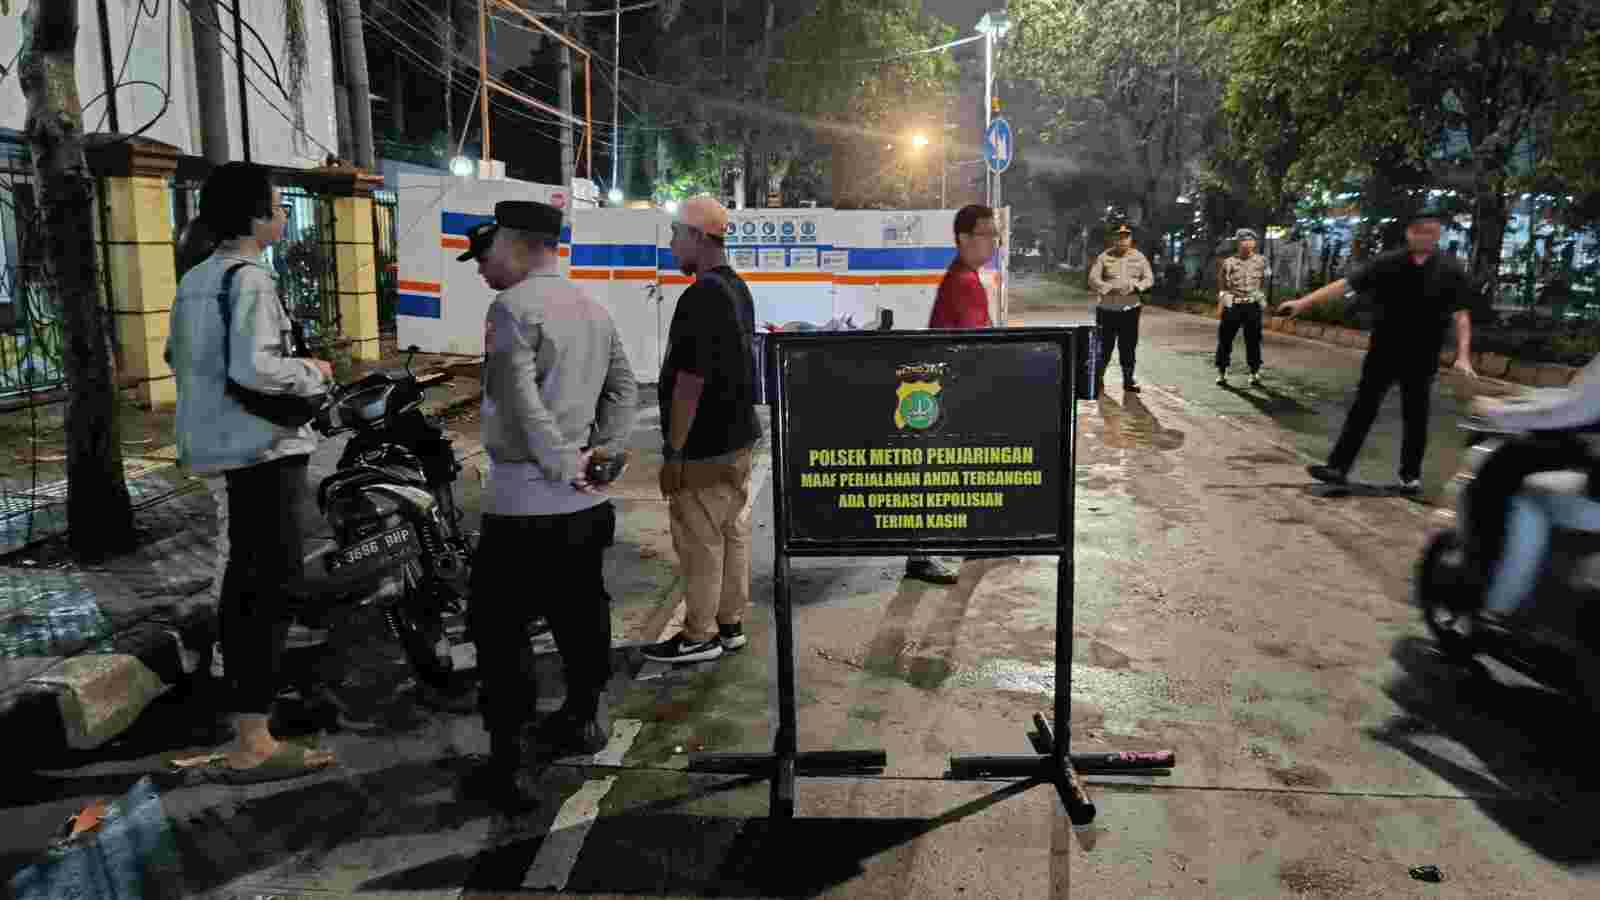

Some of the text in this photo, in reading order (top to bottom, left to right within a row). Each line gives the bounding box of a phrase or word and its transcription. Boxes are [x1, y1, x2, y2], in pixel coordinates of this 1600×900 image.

[809, 447, 1033, 466] POLSEK METRO PENJARINGAN
[800, 470, 1042, 487] MAAF PERJALANAN ANDA TERGANGGU
[839, 492, 1003, 508] ADA OPERASI KEPOLISIAN
[874, 513, 967, 529] TERIMA KASIH
